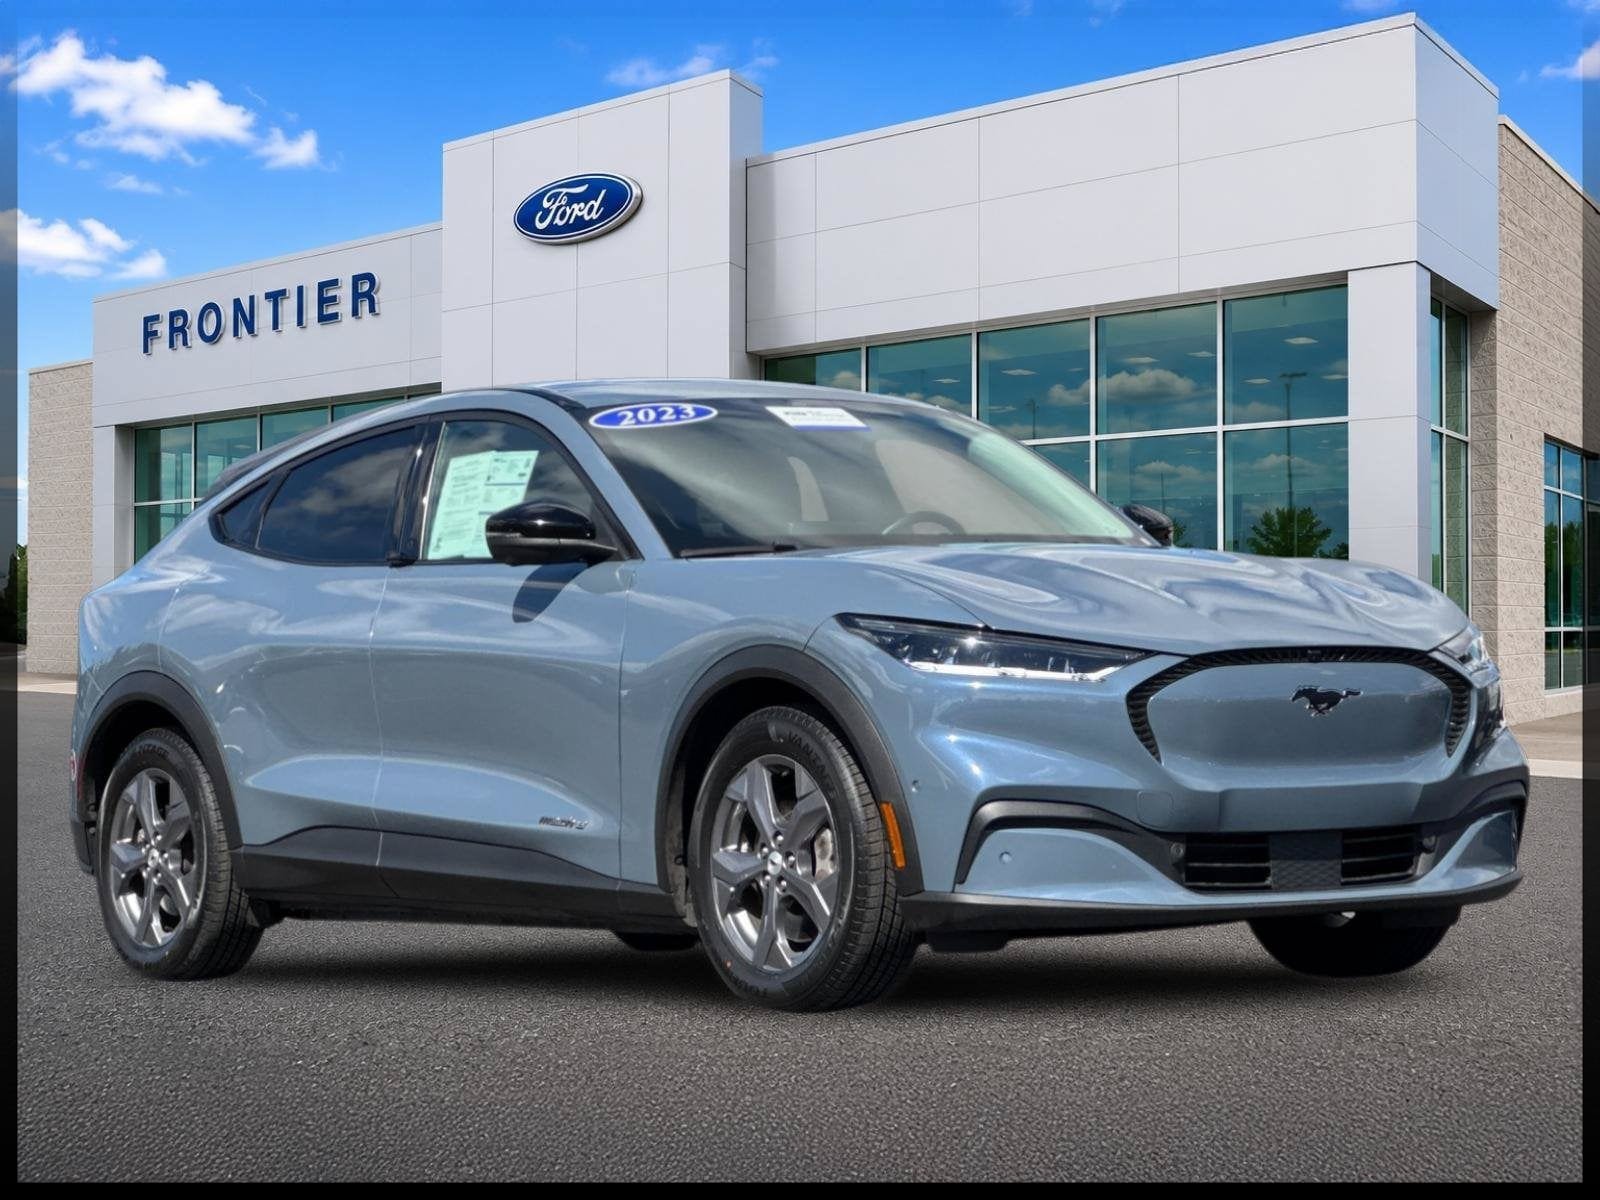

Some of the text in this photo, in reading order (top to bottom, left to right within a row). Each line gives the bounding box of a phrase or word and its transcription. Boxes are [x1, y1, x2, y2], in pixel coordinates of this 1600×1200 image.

[534, 184, 607, 230] Ford
[142, 271, 380, 355] FRONTIER
[617, 404, 696, 426] 2023
